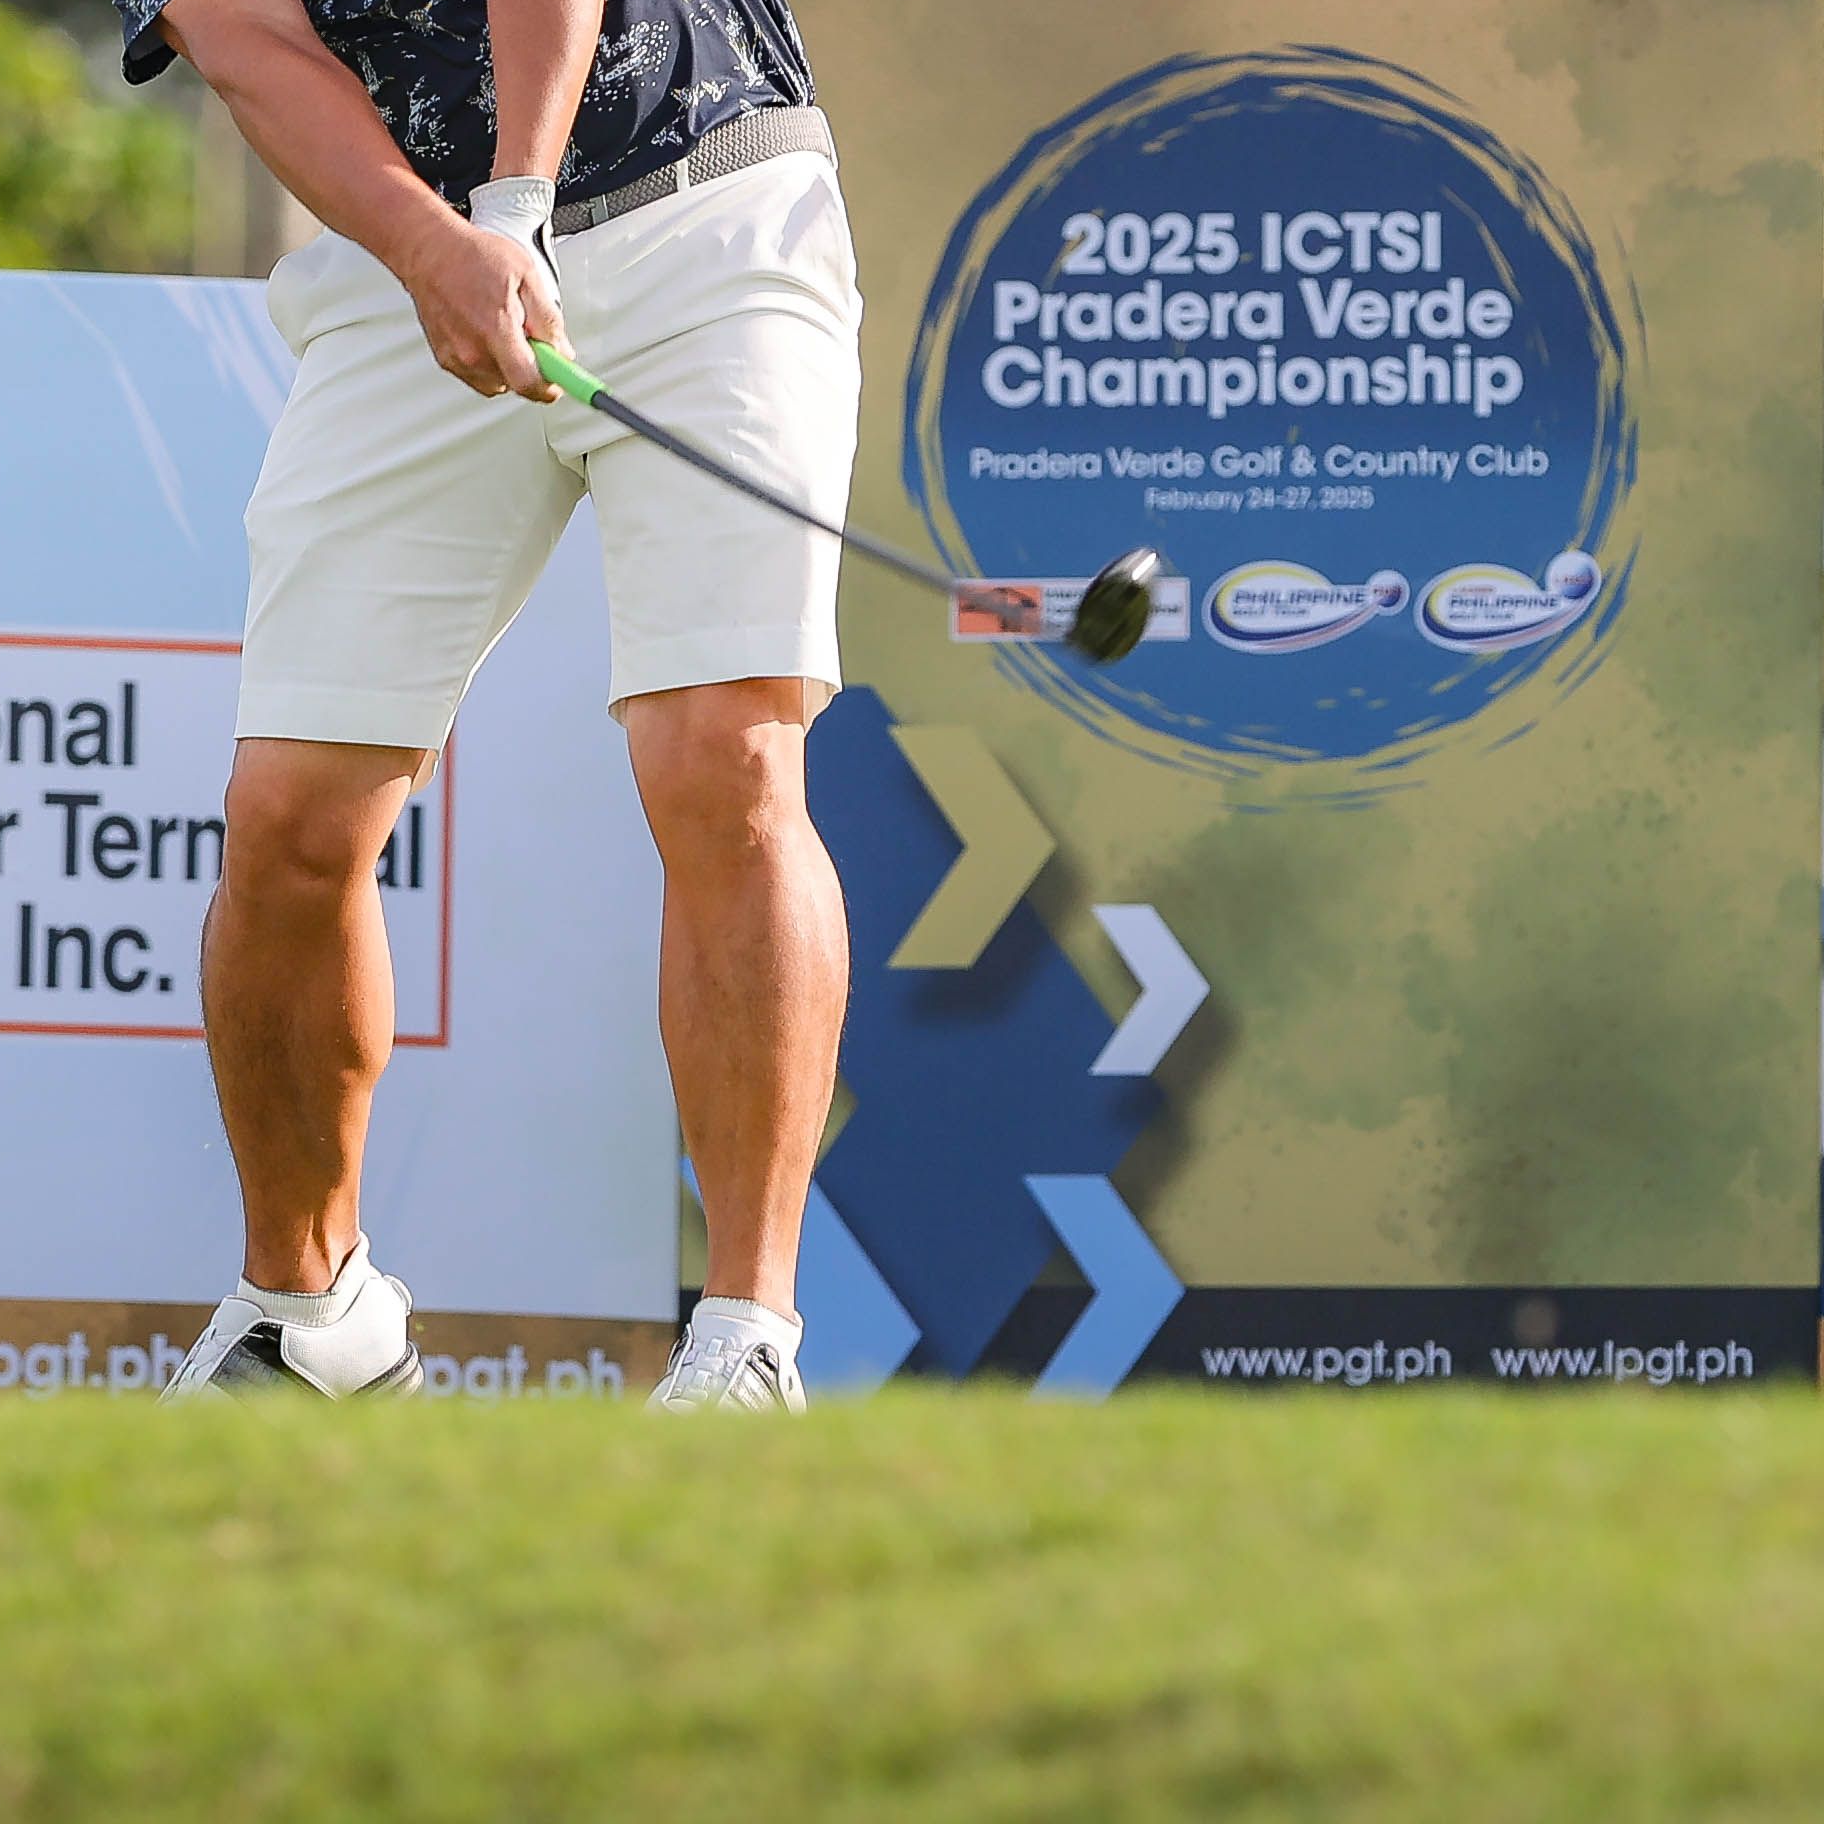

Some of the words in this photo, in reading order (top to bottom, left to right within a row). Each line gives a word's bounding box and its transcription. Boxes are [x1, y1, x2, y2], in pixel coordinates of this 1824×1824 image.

[1062, 212, 1240, 275] 2025
[1261, 210, 1442, 274] ICTSI
[993, 279, 1284, 341] Pradera
[1298, 277, 1514, 339] Verde
[982, 344, 1525, 419] Championship
[970, 447, 1102, 479] Pradera
[1105, 446, 1205, 478] Verde
[1210, 445, 1284, 477] Golf
[1289, 444, 1317, 477] &
[1324, 444, 1460, 482] Country
[1466, 444, 1549, 476] Club
[1144, 487, 1244, 513] February
[18, 903, 174, 993] Inc.
[422, 1344, 625, 1406] pgt.ph
[1201, 1340, 1452, 1386] www.pgt.ph
[1490, 1339, 1753, 1386] www.lpgt.ph
